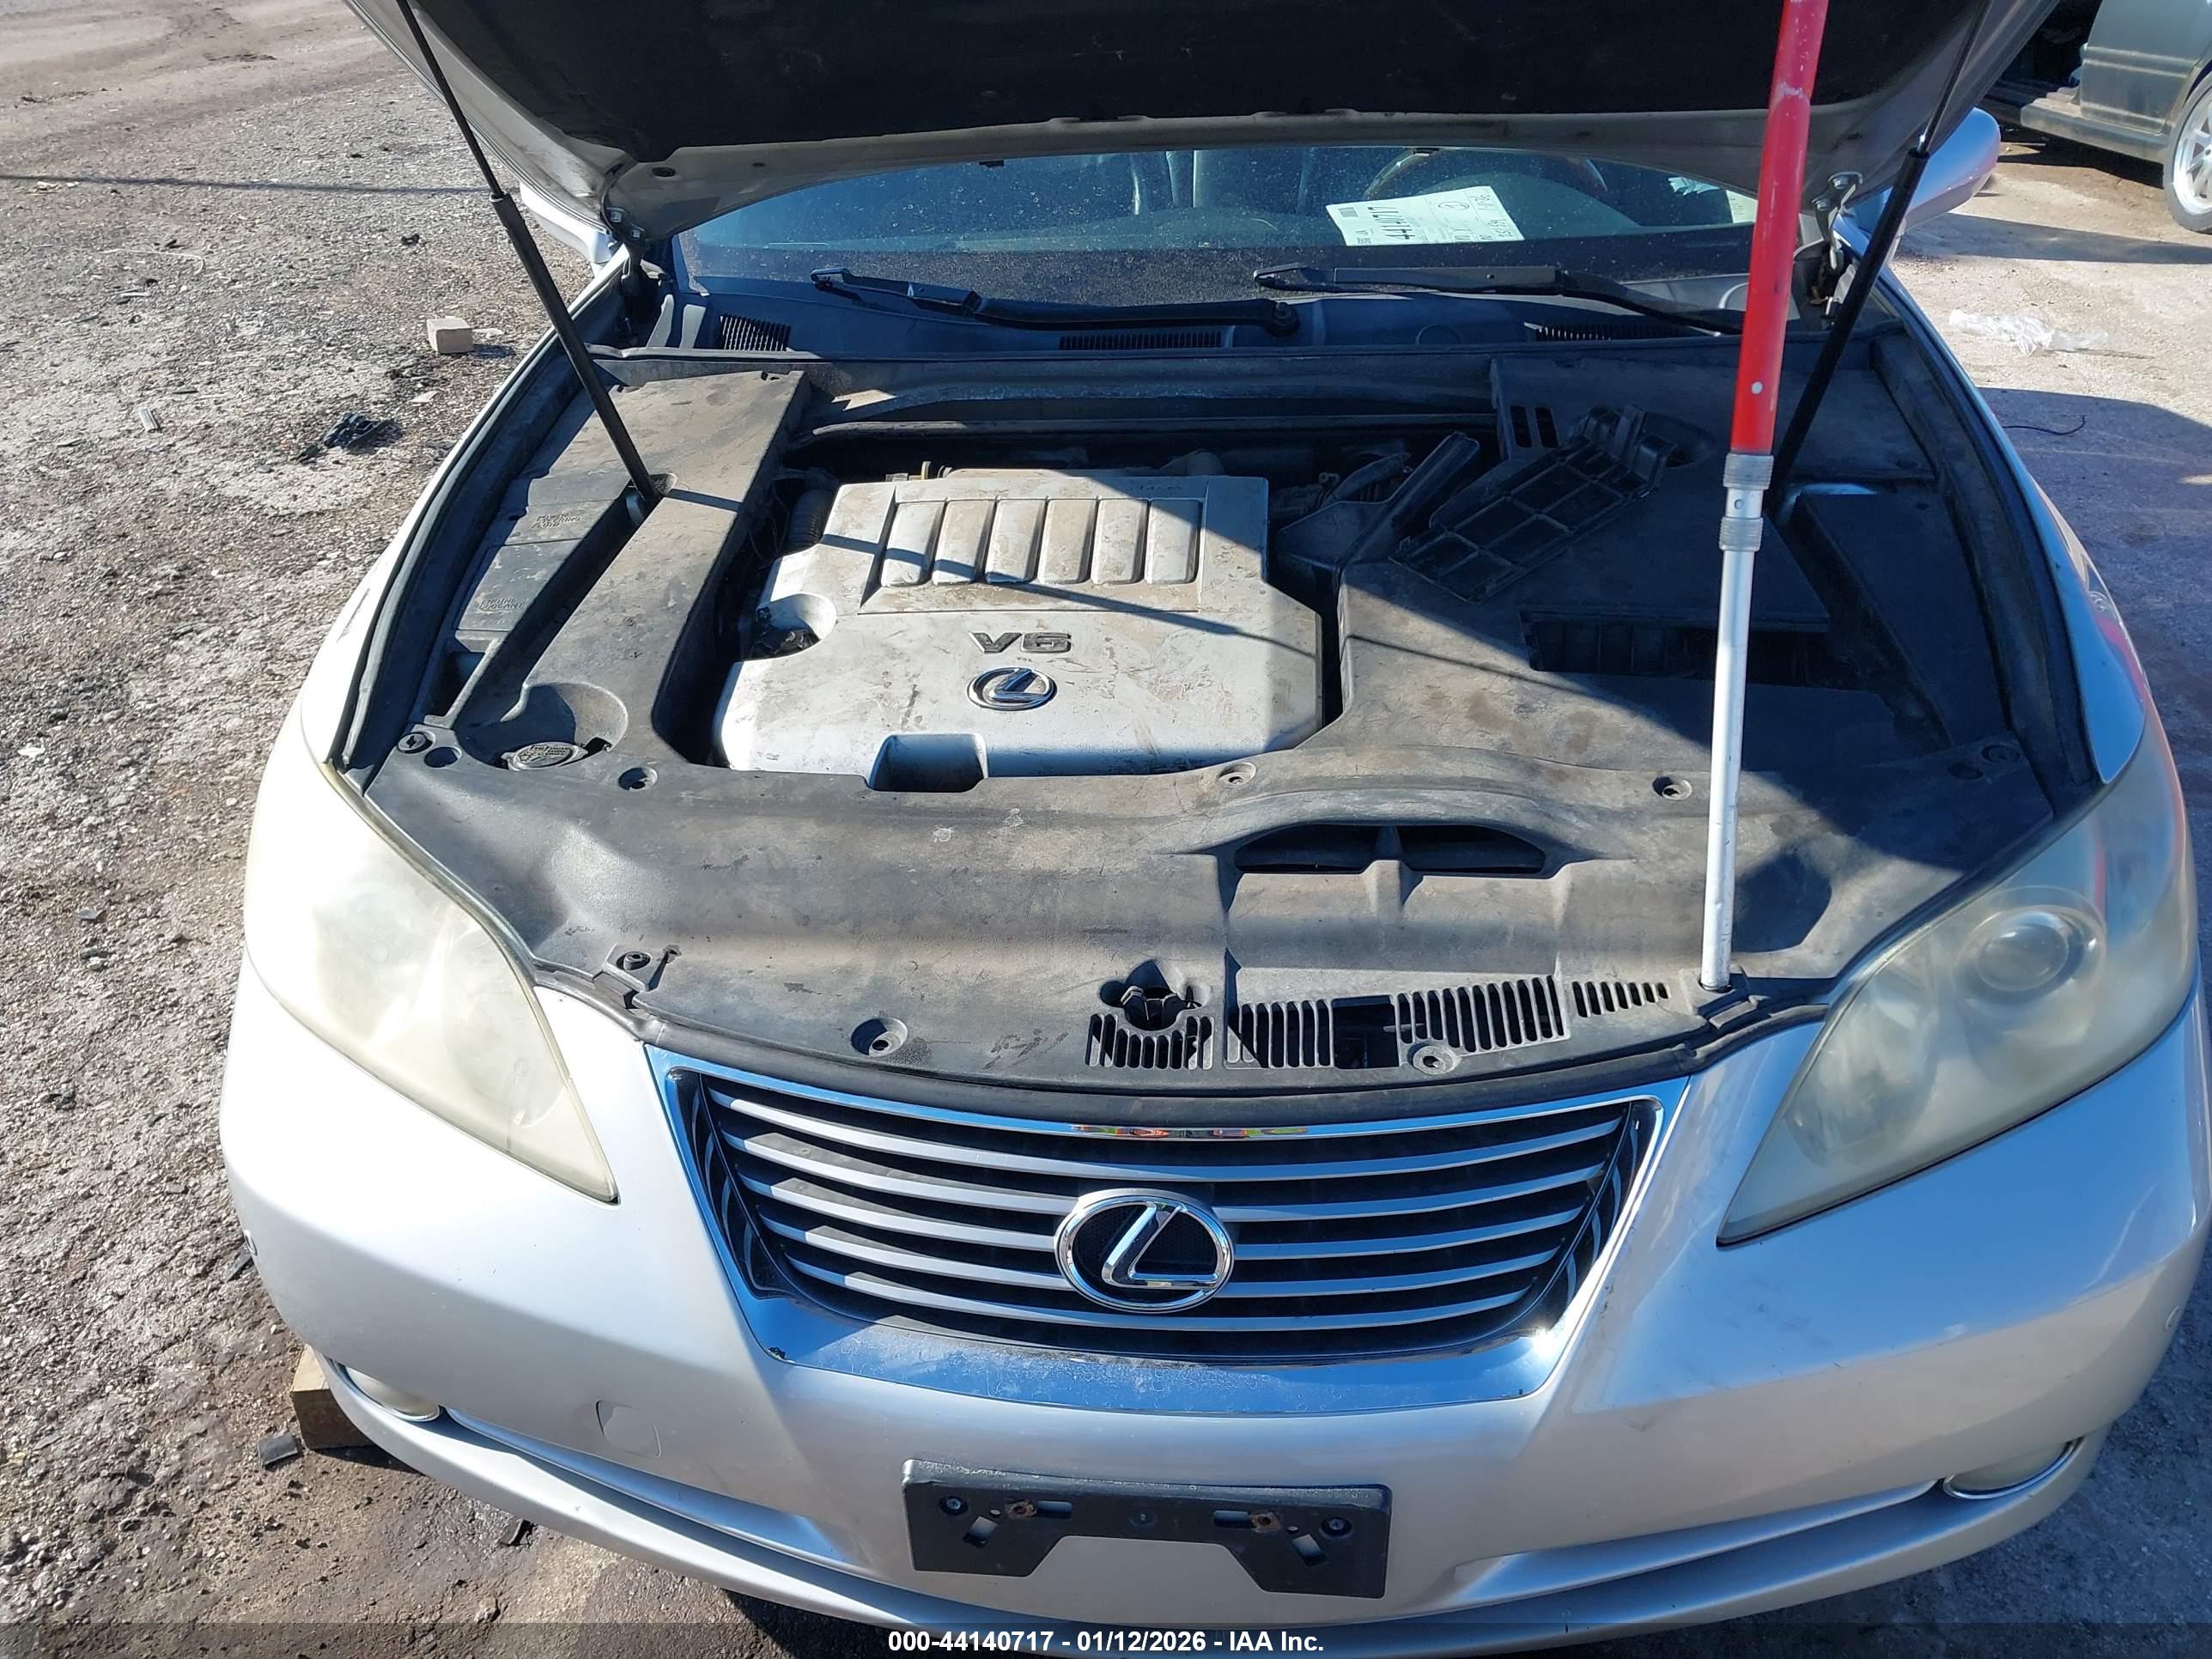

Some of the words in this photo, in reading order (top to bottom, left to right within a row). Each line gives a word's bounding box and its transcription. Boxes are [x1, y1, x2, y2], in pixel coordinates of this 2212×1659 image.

[1367, 206, 1416, 240] 44140717
[478, 603, 523, 611] COOLANT
[968, 631, 1072, 653] V6
